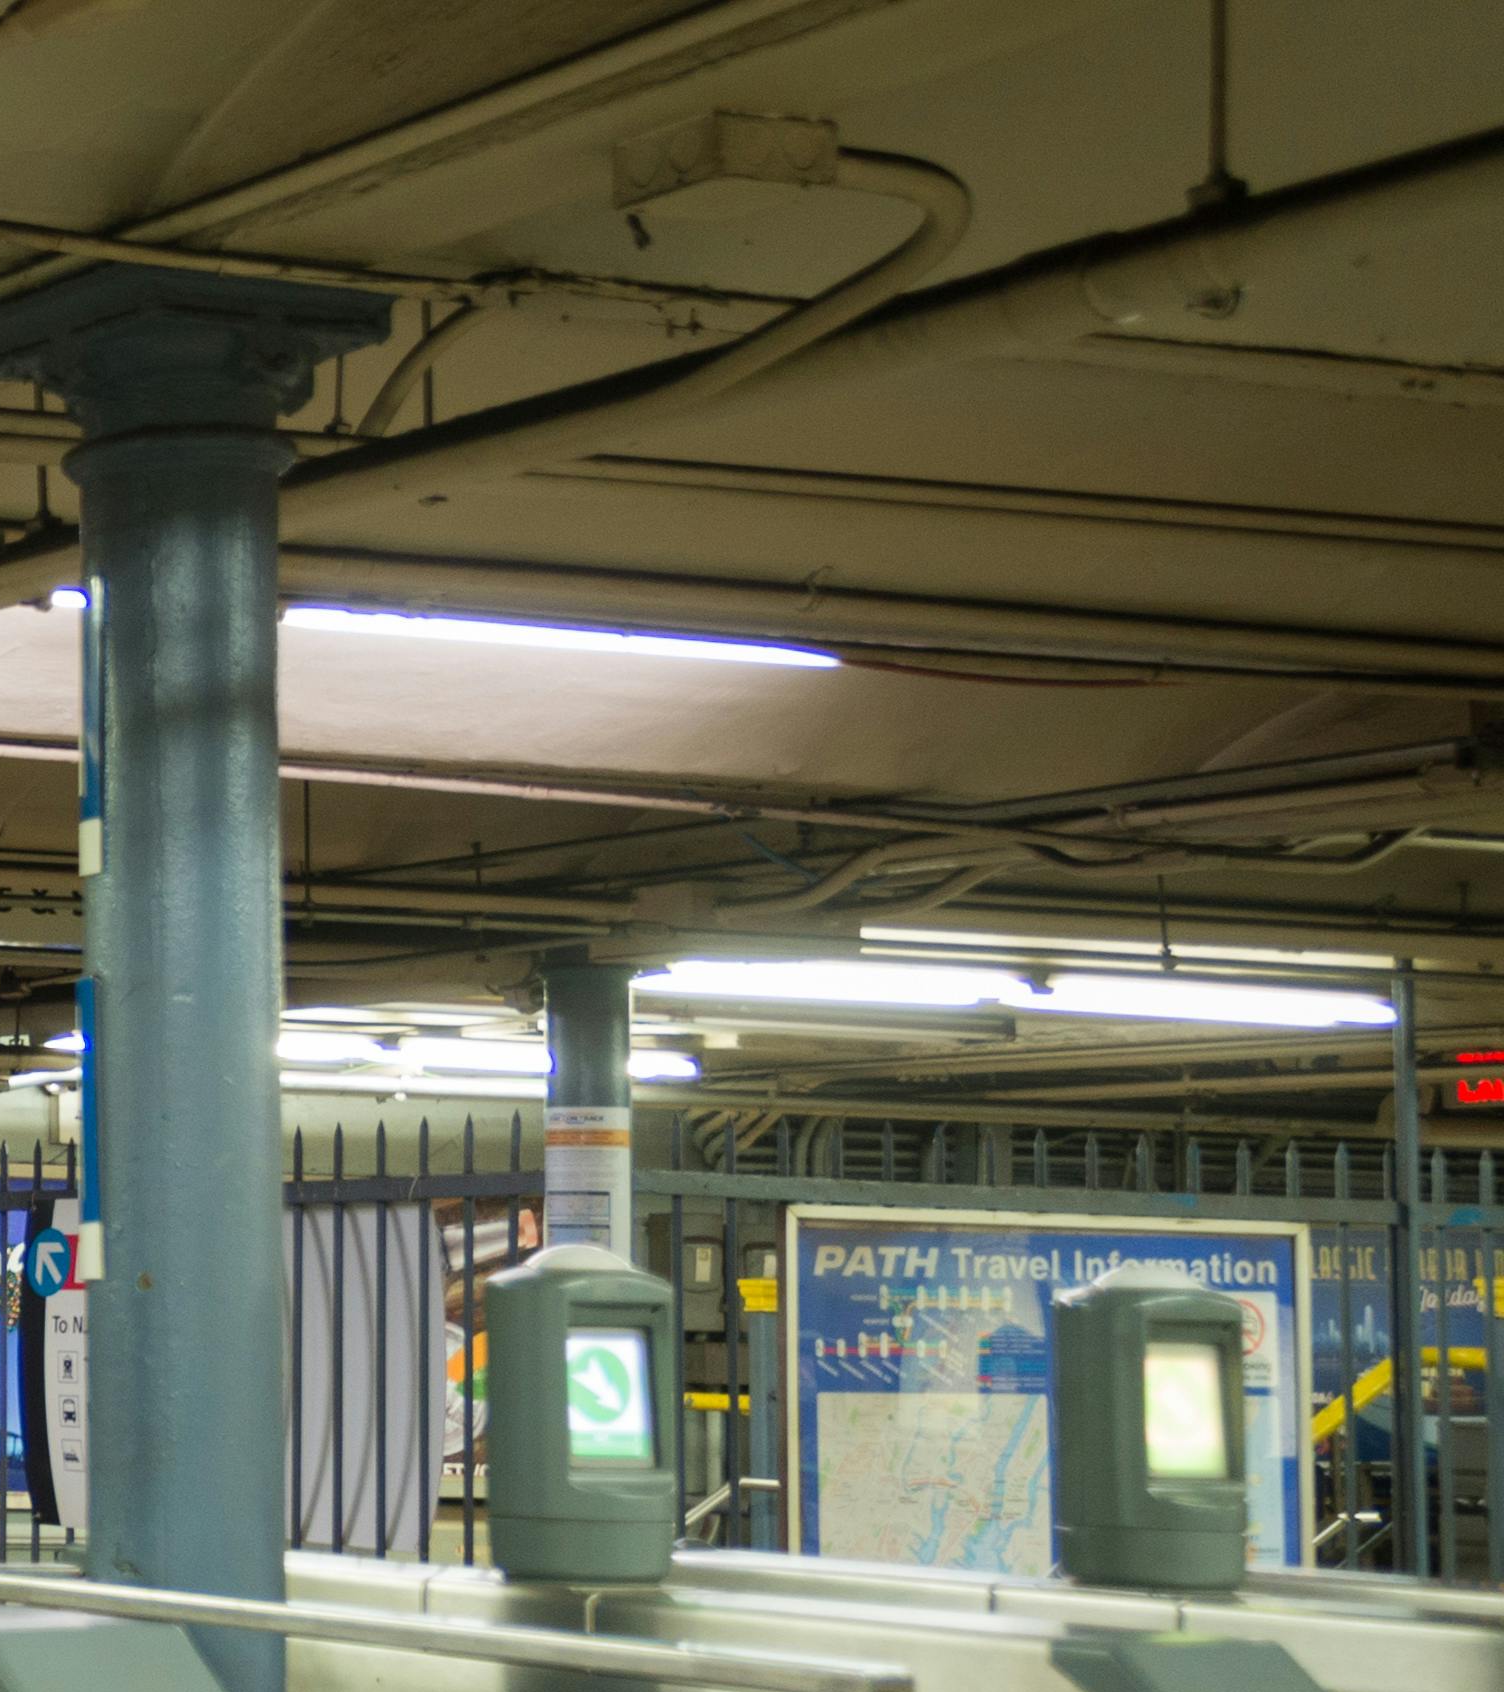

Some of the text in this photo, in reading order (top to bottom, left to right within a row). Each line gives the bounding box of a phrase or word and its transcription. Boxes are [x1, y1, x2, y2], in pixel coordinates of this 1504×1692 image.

[812, 1245, 939, 1278] PATH
[951, 1248, 1060, 1281] Travel
[52, 1315, 88, 1334] To N
